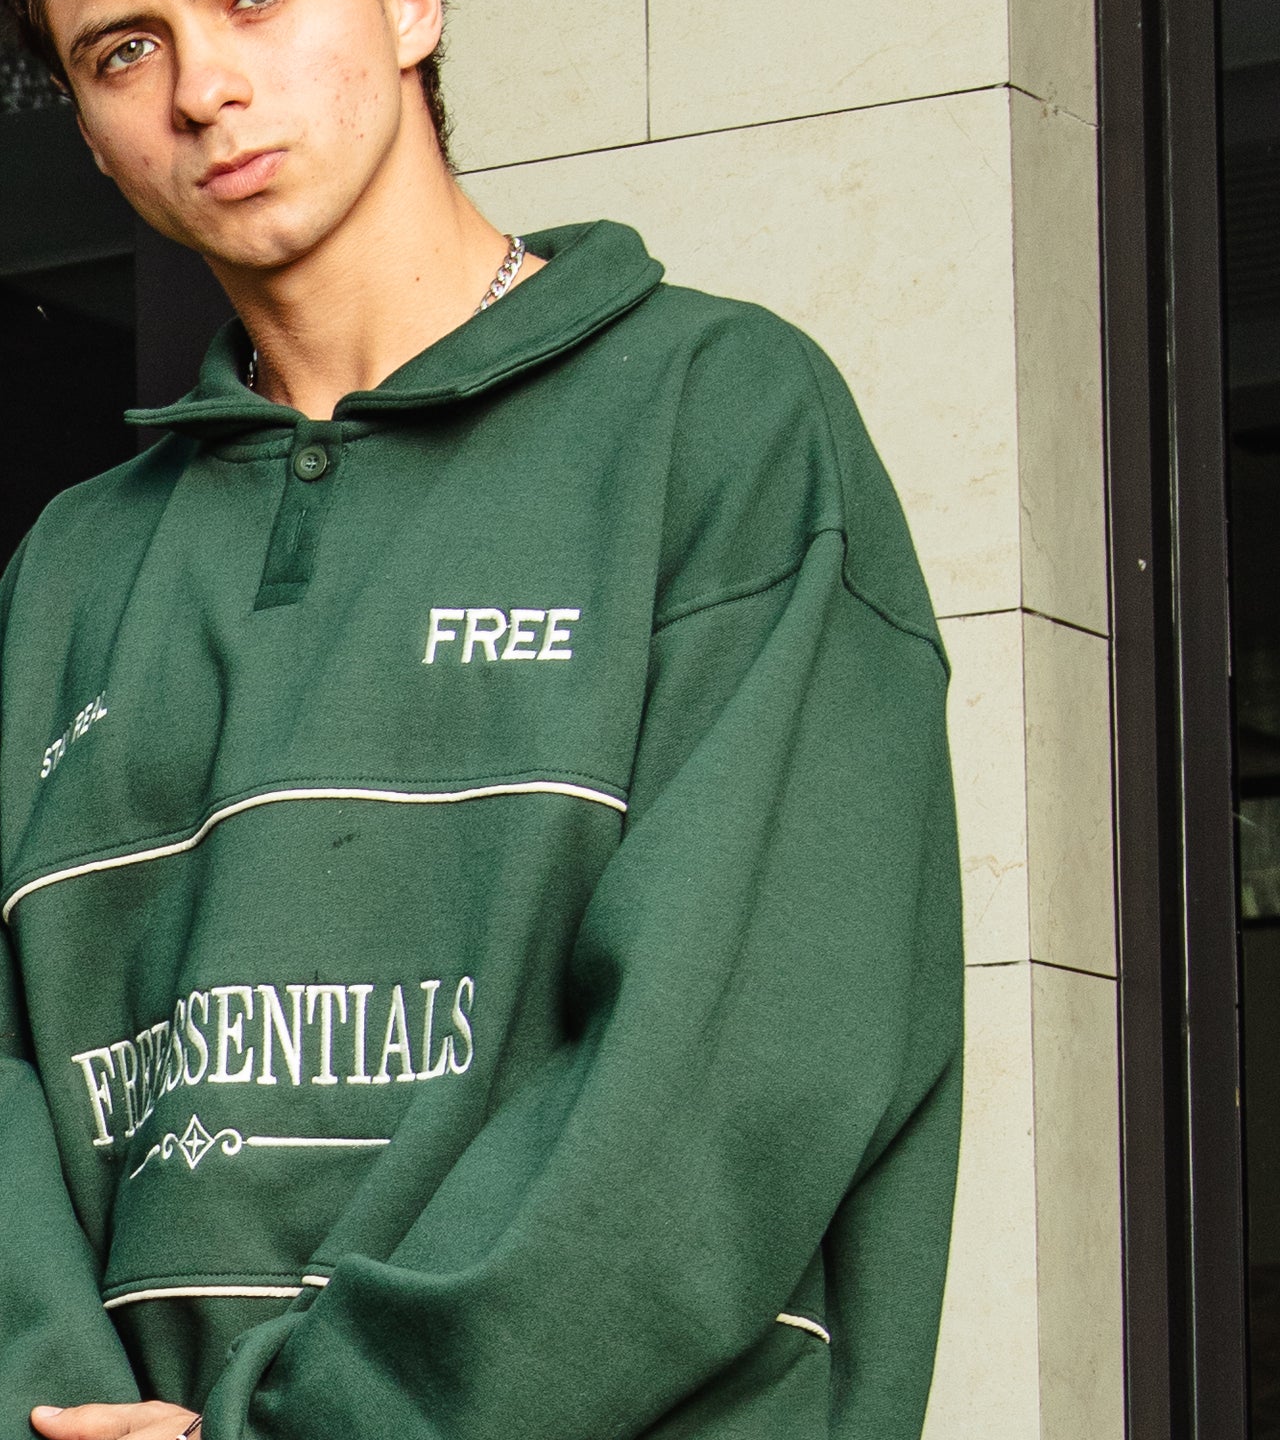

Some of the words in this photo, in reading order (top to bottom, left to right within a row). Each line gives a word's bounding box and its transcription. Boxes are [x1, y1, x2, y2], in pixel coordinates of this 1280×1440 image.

[421, 608, 581, 665] FREE
[40, 722, 72, 778] ST
[160, 975, 476, 1098] SSENTIALS
